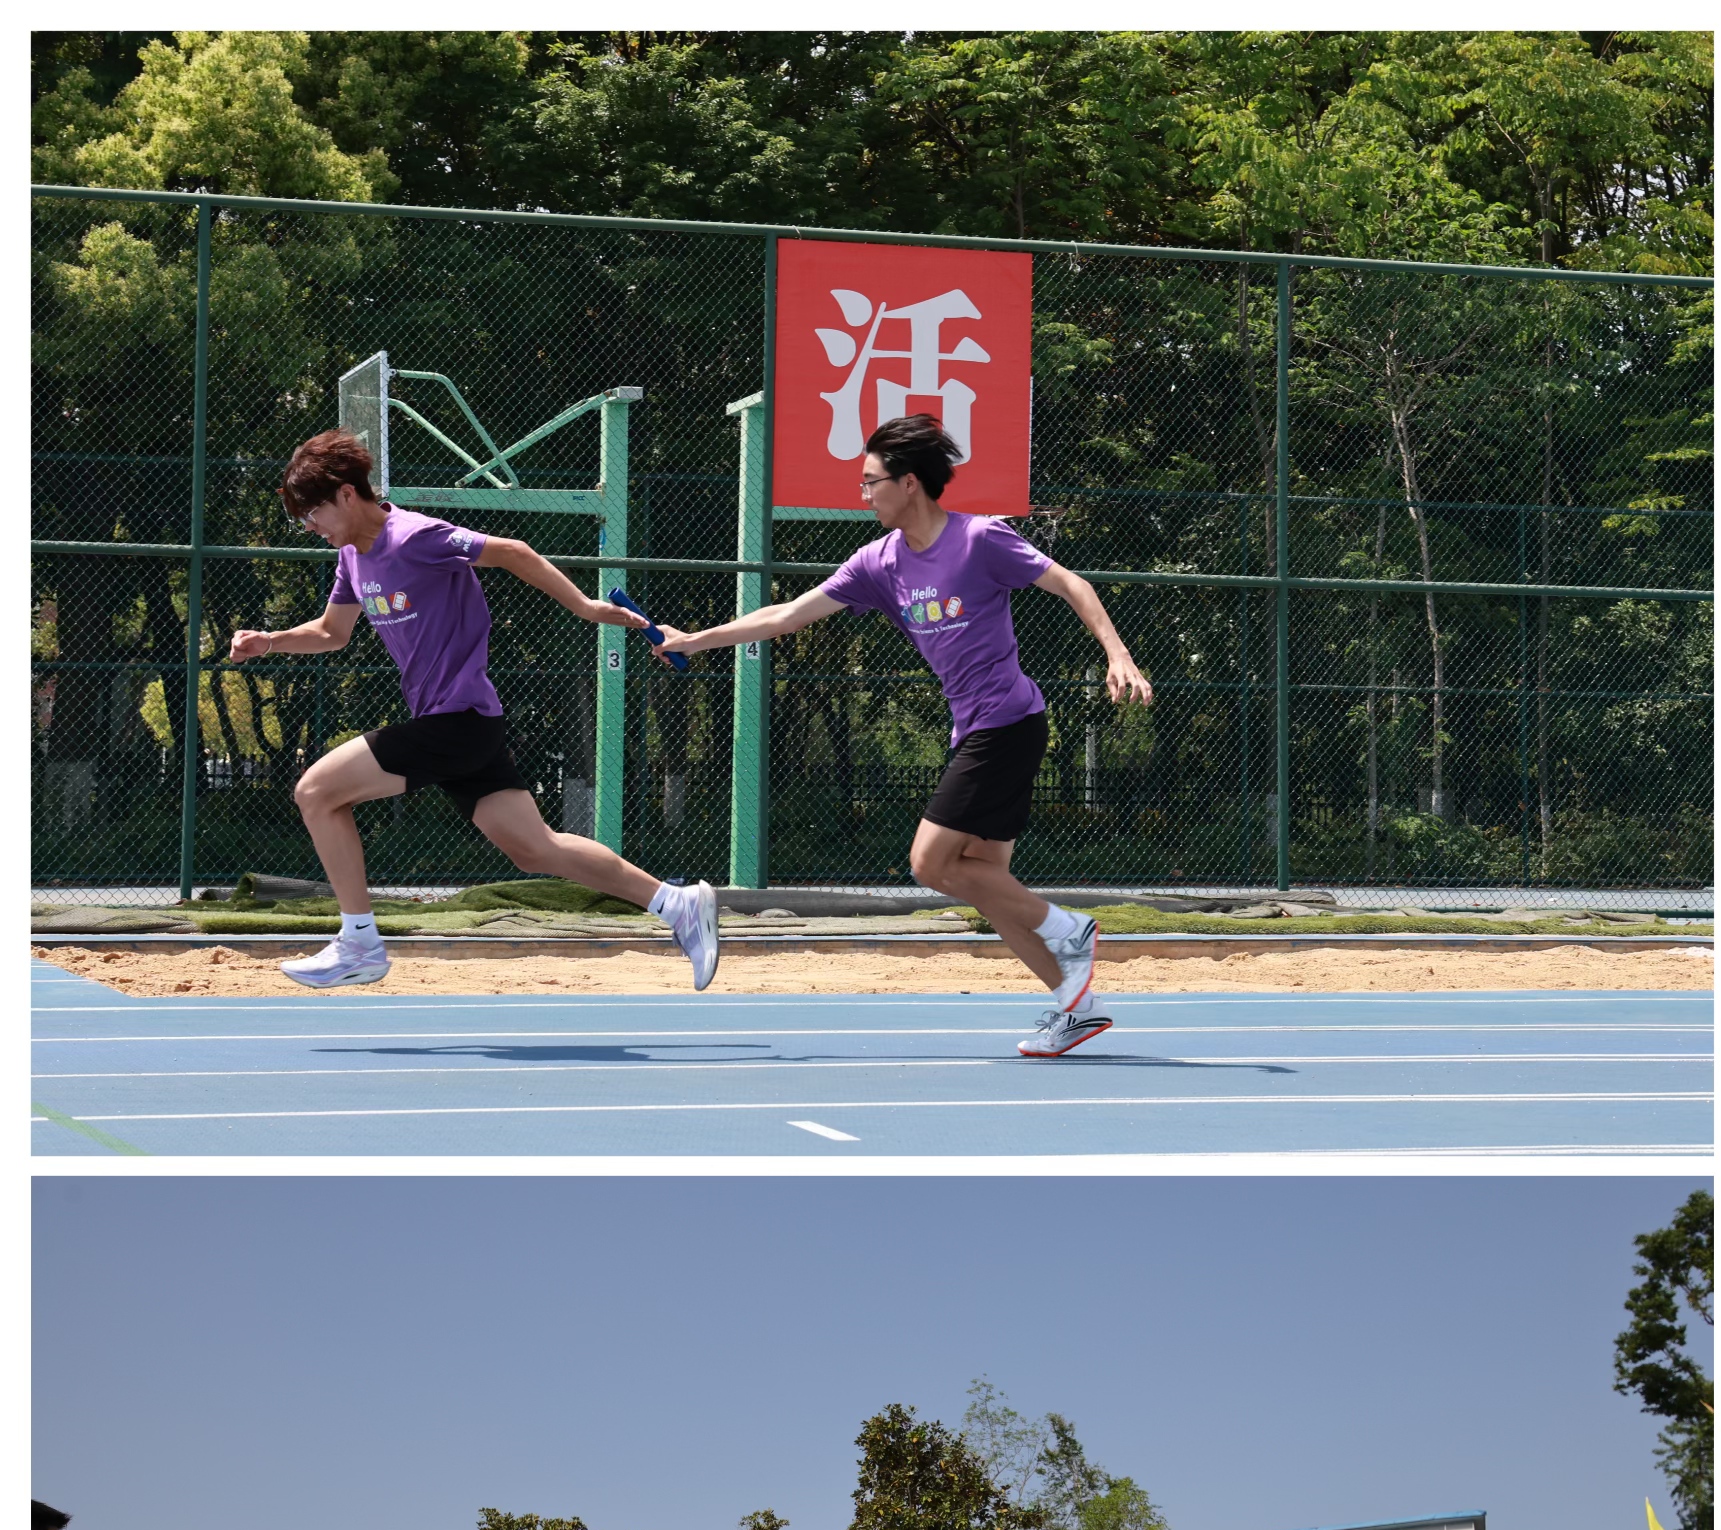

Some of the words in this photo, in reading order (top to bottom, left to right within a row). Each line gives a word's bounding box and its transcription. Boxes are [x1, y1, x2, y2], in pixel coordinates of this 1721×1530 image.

[815, 289, 990, 466] 活
[362, 580, 382, 594] Hello
[911, 586, 938, 601] Hello
[940, 620, 970, 632] Technology
[747, 641, 759, 656] 4
[609, 652, 620, 668] 3
